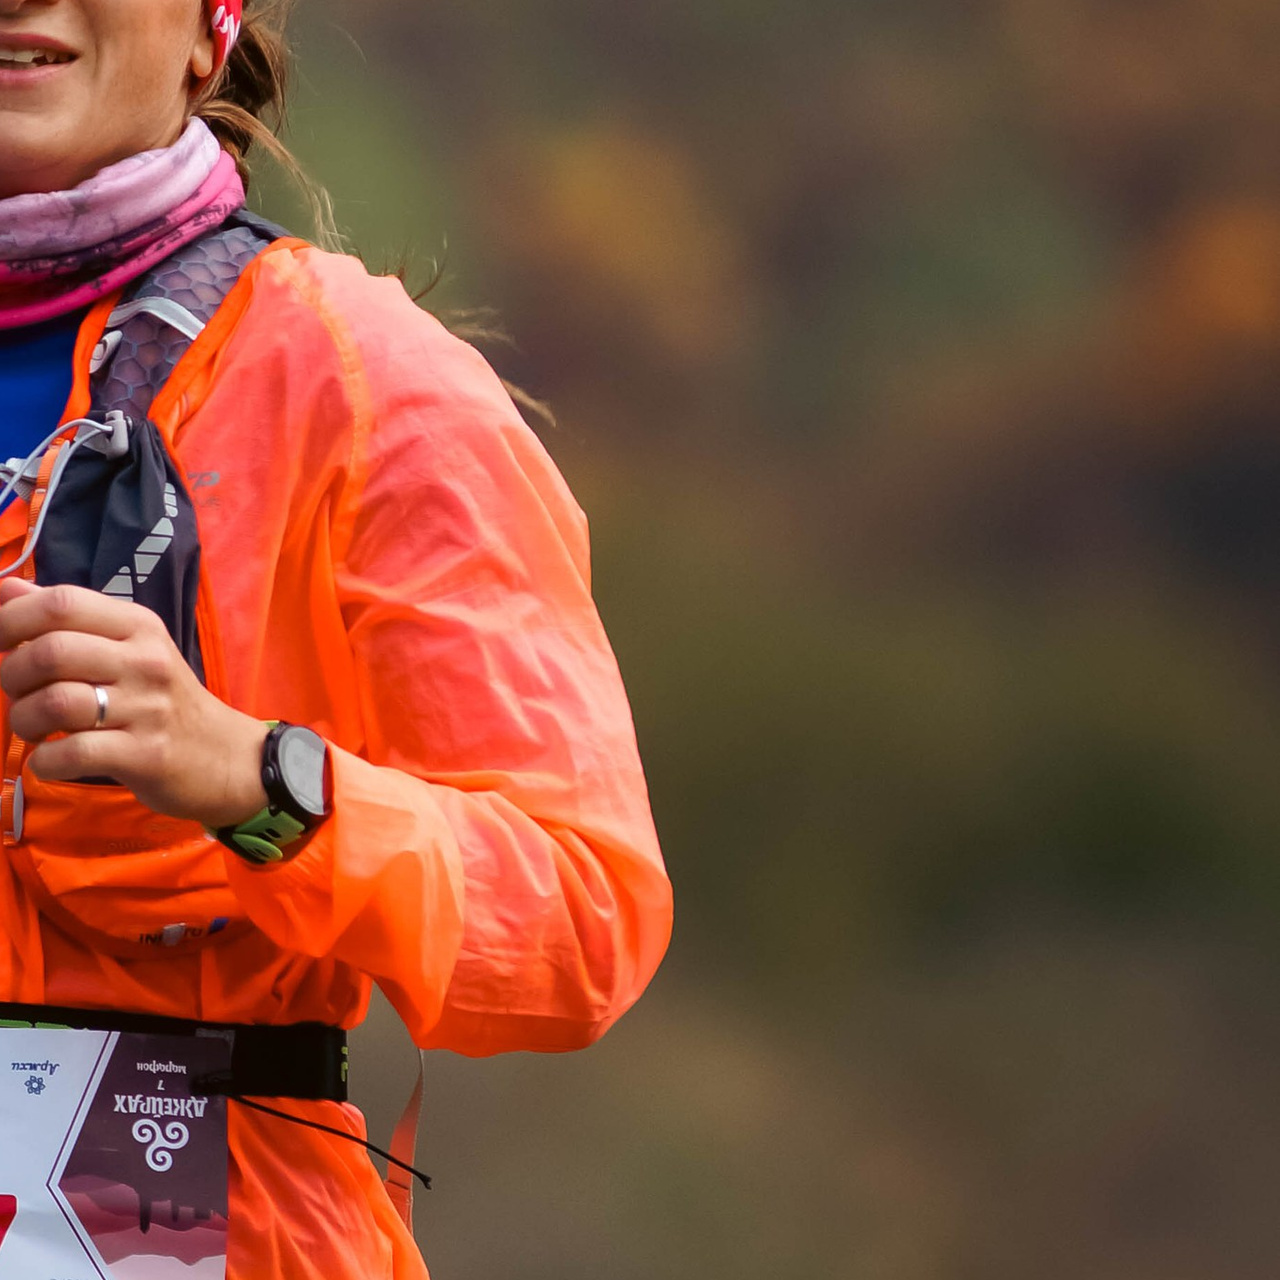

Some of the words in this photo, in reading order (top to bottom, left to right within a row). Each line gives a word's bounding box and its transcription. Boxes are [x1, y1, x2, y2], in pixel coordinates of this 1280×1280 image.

[11, 1060, 60, 1076] Армхи
[136, 1060, 187, 1074] марафон
[113, 1094, 208, 1118] ДЖЕЙРАХ
